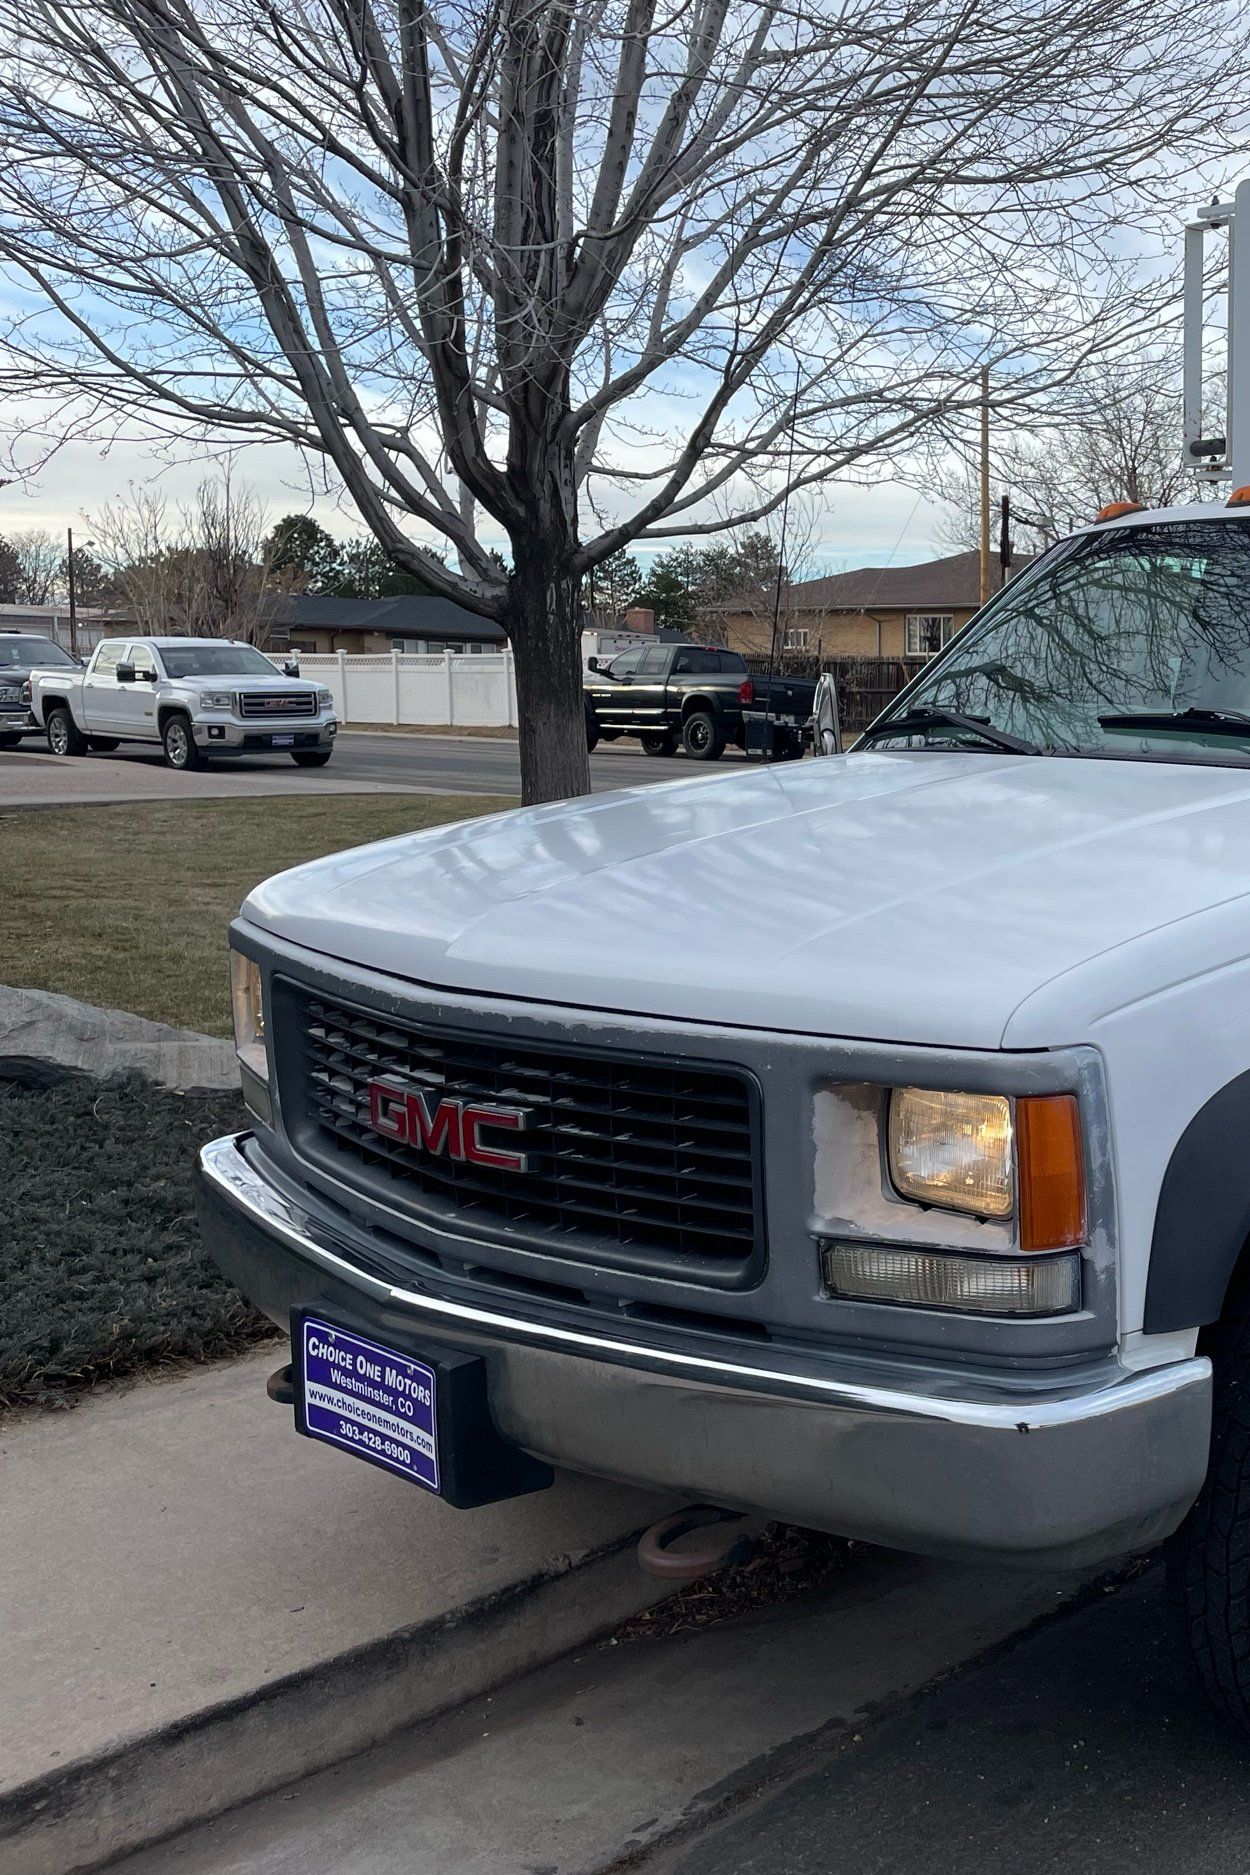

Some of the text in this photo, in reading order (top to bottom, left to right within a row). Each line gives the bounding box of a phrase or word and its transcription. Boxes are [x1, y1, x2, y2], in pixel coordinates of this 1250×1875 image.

[369, 1074, 529, 1173] GMC
[308, 1336, 431, 1407] CHOICE ONE MOTORS
[330, 1368, 414, 1417] Westminster, CO
[308, 1387, 434, 1454] www.choiceonemotors.com
[339, 1420, 411, 1465] 303-428-6900
